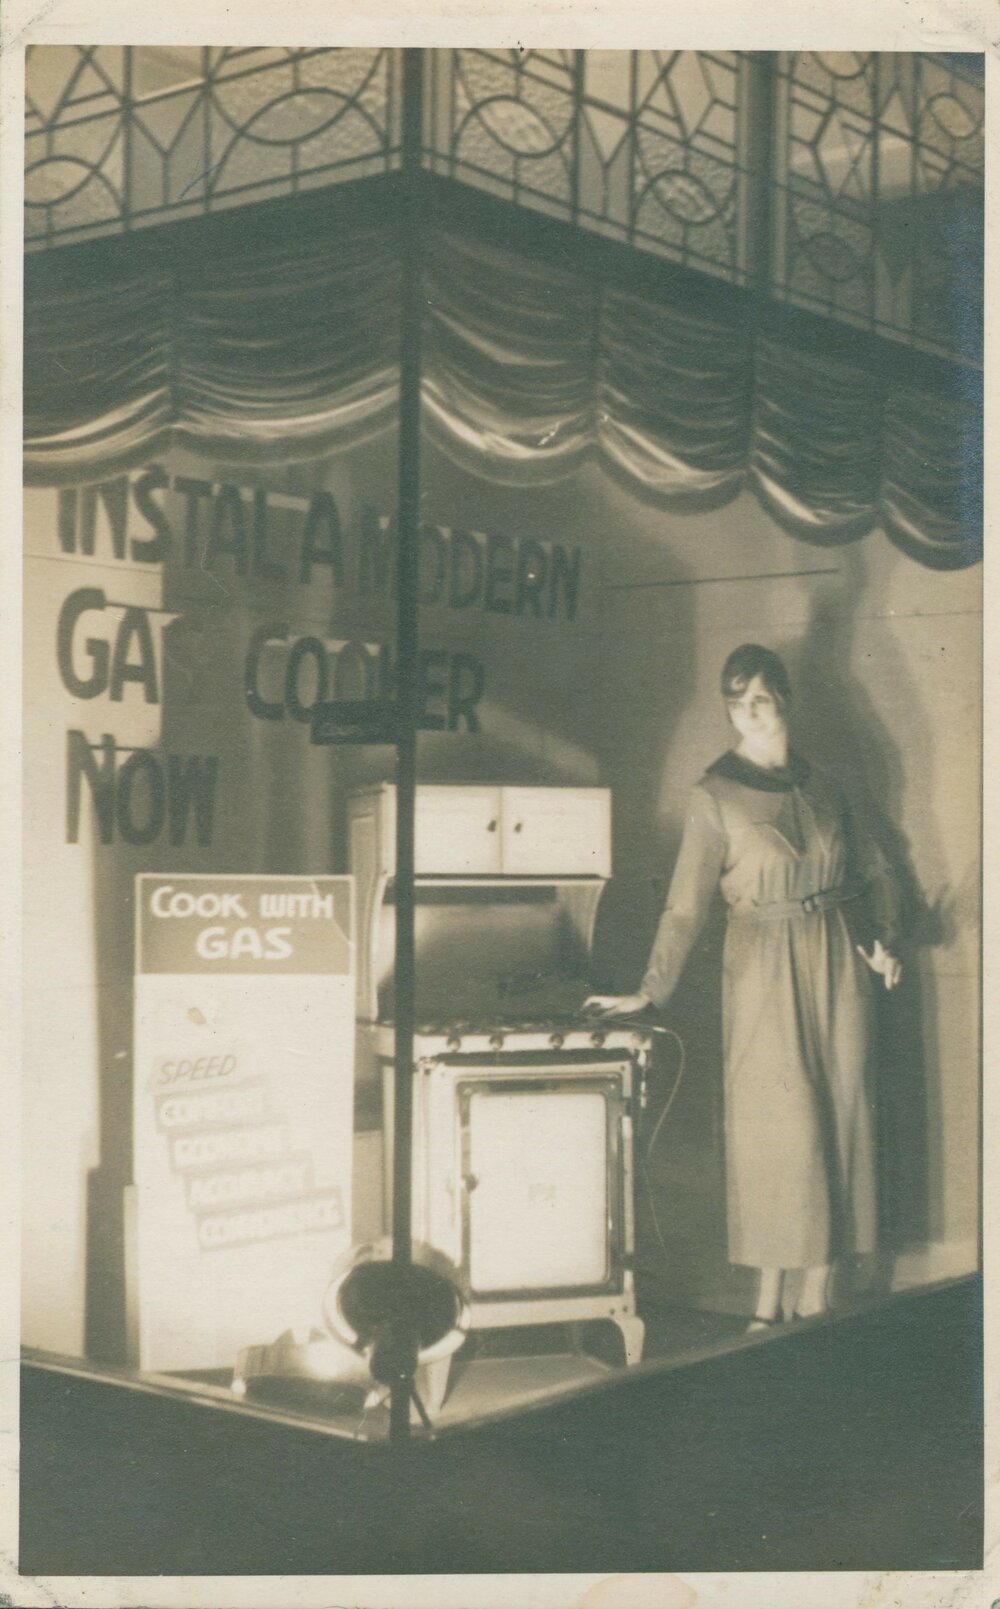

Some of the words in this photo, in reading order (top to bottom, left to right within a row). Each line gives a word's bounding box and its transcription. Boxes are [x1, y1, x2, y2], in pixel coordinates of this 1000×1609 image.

[57, 466, 286, 580] INSTAL
[301, 490, 344, 590] A
[65, 729, 218, 846] NOW
[150, 886, 247, 919] COOK
[259, 893, 334, 919] WITH
[195, 926, 293, 960] GAS
[157, 1055, 237, 1085] SPEED
